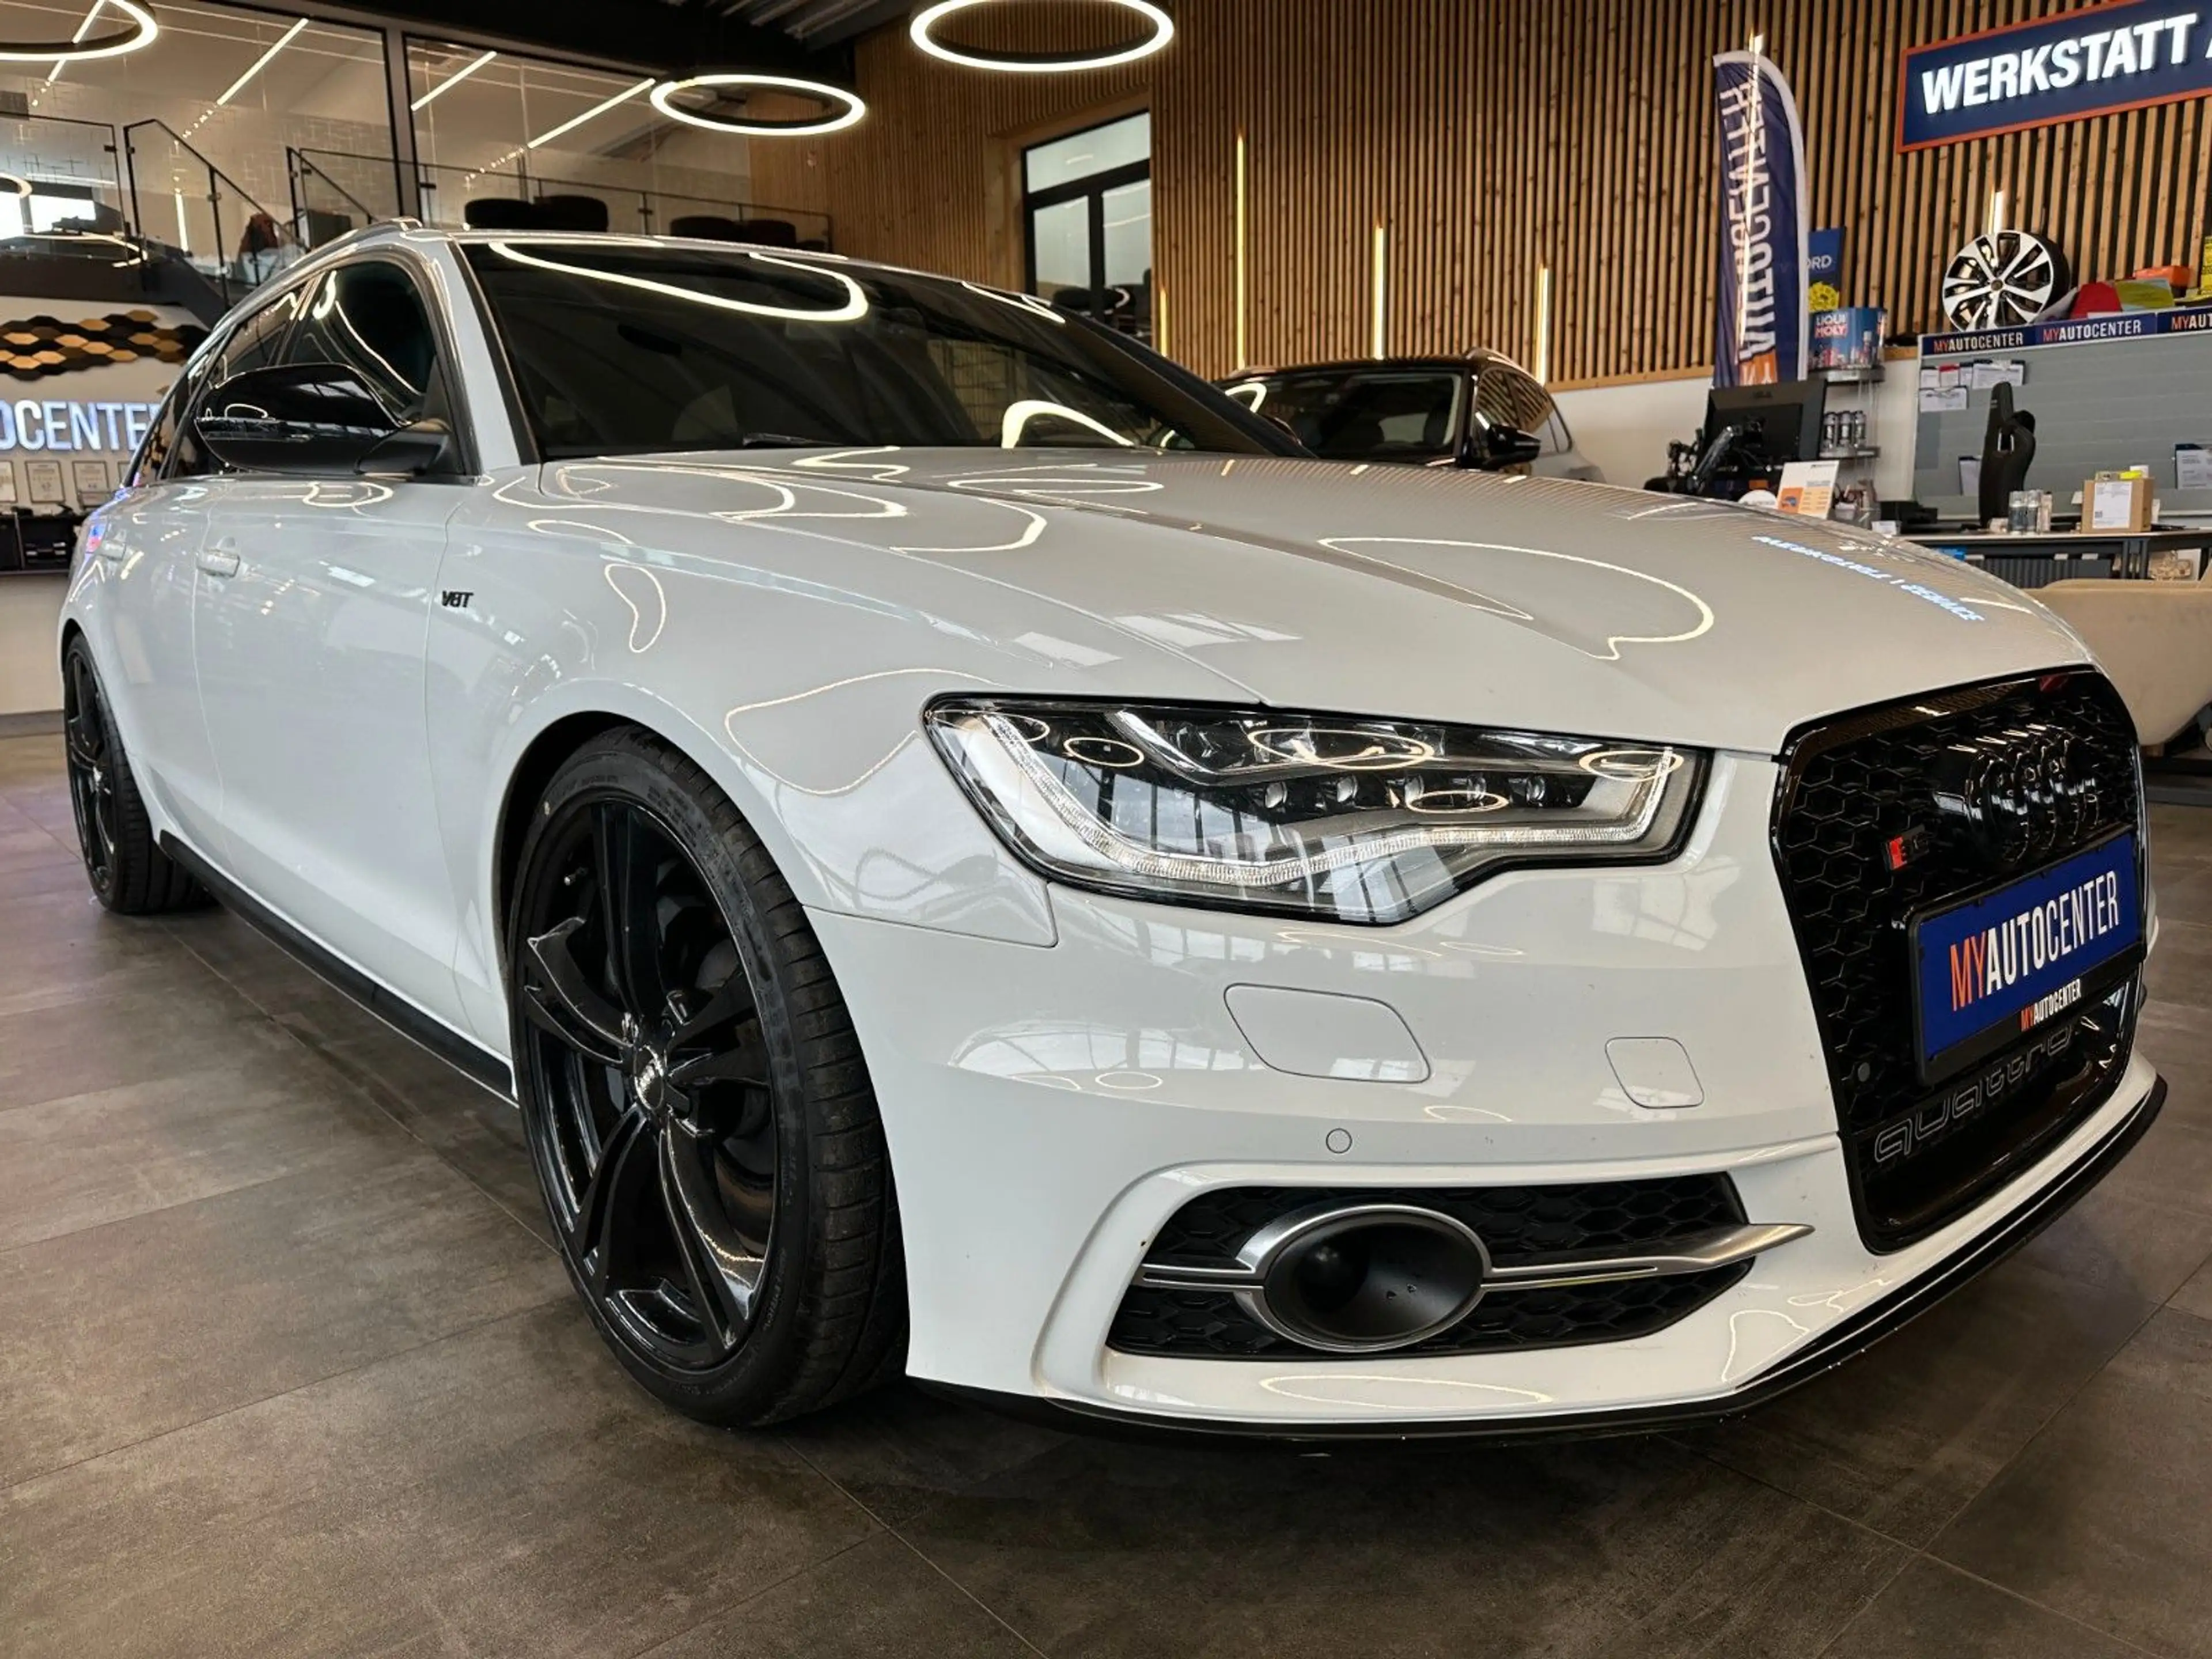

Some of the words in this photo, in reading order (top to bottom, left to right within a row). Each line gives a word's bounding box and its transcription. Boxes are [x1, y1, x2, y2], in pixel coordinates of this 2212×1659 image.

[1922, 13, 2196, 114] WERKSTATT
[1933, 332, 2024, 353] MYAUTOCENTER
[2043, 320, 2141, 342] MYAUTOCENTER
[1950, 871, 2119, 1012] MYAUTOCENTER
[2021, 978, 2081, 1032] MYAUTOCENTER
[1874, 1025, 2072, 1163] quattro
